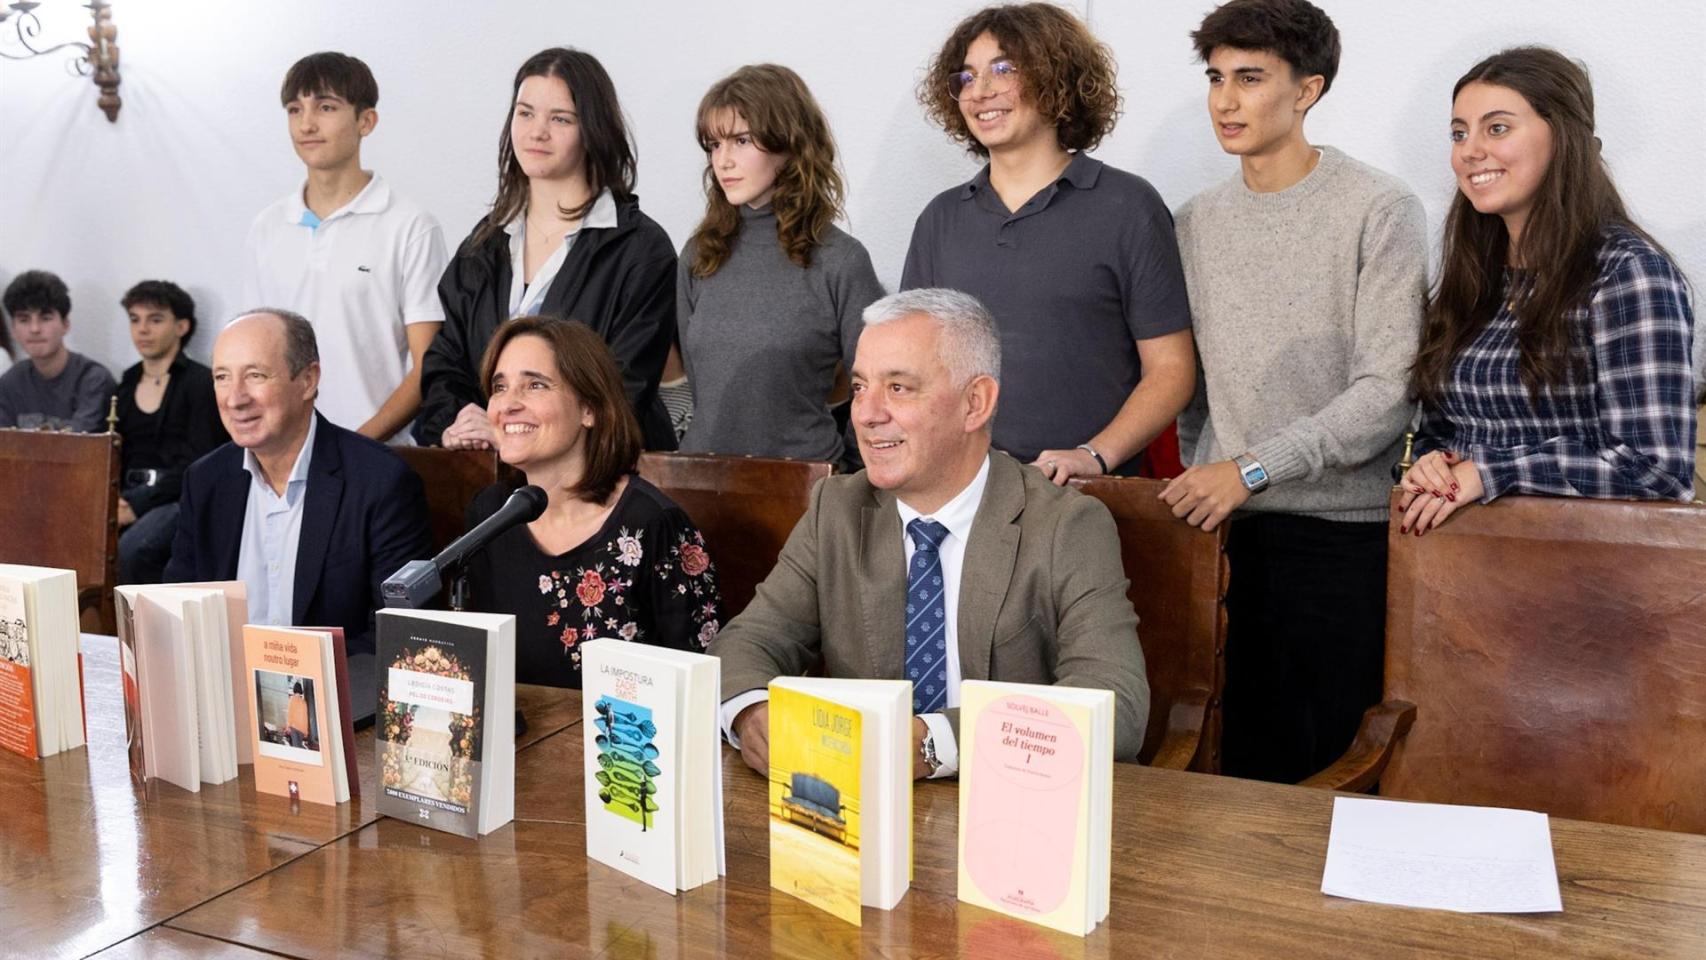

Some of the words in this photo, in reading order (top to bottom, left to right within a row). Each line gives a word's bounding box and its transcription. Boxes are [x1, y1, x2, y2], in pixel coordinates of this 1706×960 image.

[264, 641, 267, 649] a
[269, 641, 283, 652] miña
[285, 641, 297, 654] vida
[264, 654, 283, 664] noutro
[284, 656, 299, 668] lugar
[601, 664, 610, 674] LA
[611, 667, 654, 687] IMPOSTURA
[616, 678, 637, 692] ZADIE
[1001, 721, 1013, 733] El
[1015, 726, 1057, 743] volumen
[1002, 735, 1018, 748] del
[1020, 740, 1056, 756] tiempo
